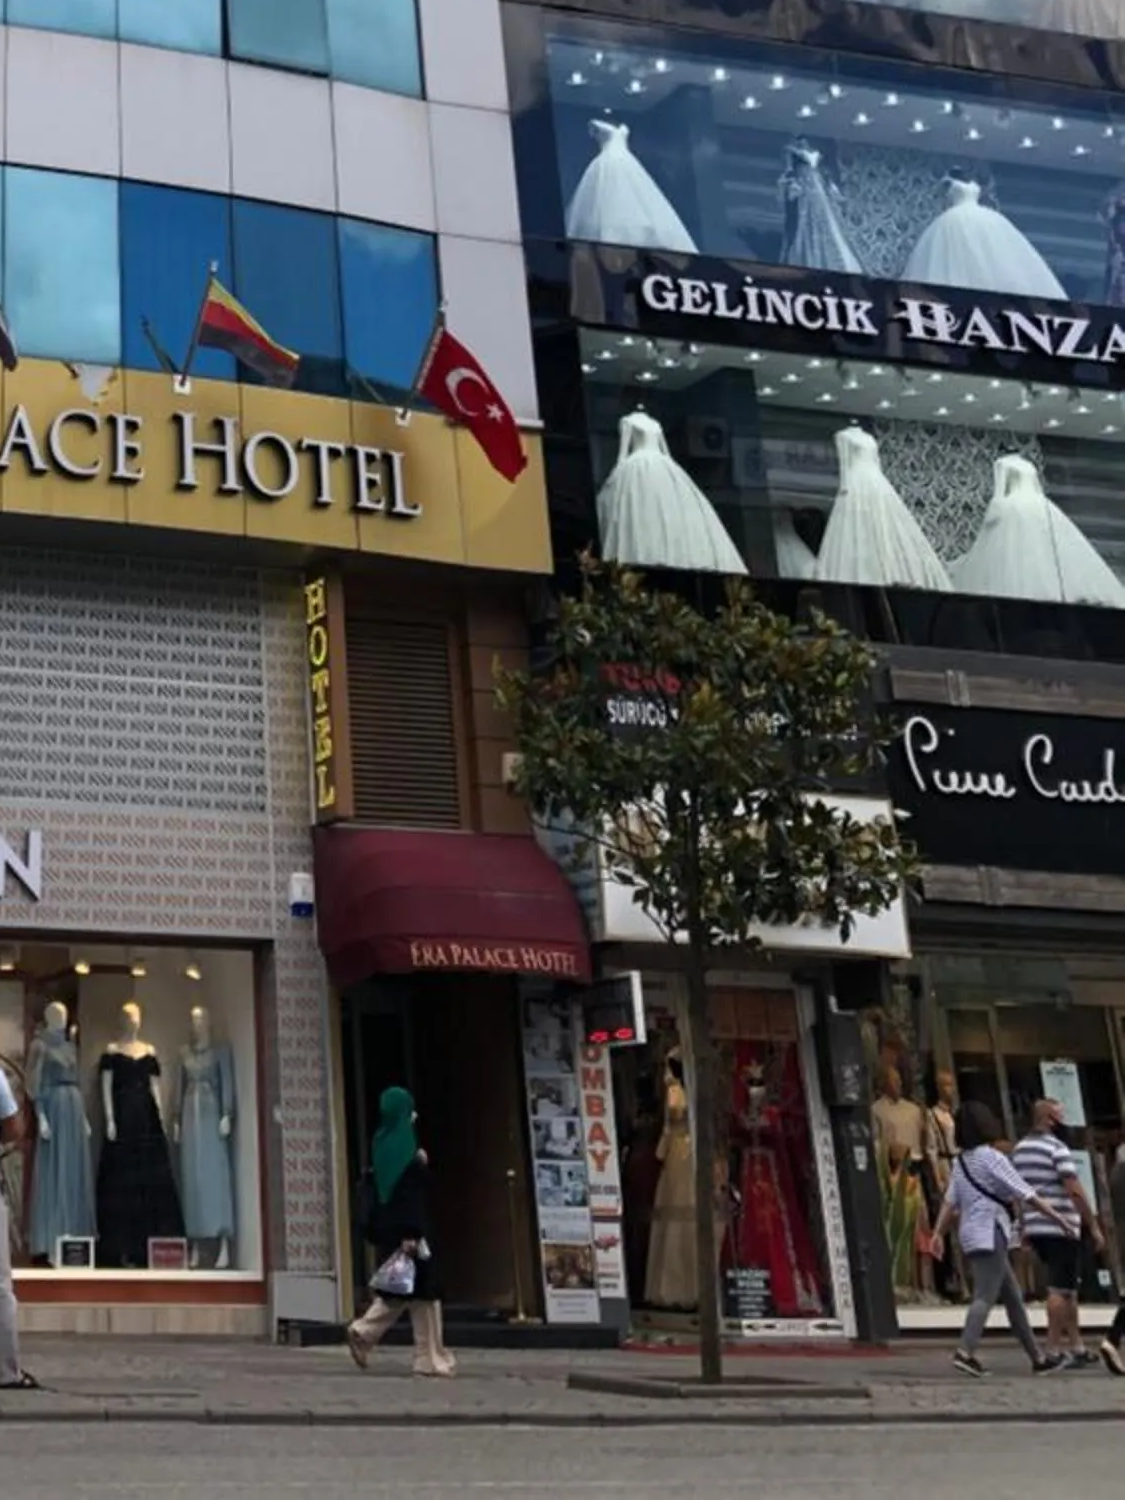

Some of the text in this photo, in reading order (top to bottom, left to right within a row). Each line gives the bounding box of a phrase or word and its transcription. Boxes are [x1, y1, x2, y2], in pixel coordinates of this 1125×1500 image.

[642, 274, 879, 336] GELİNCİK
[173, 410, 423, 518] HOTEL
[305, 575, 336, 809] HOTEL
